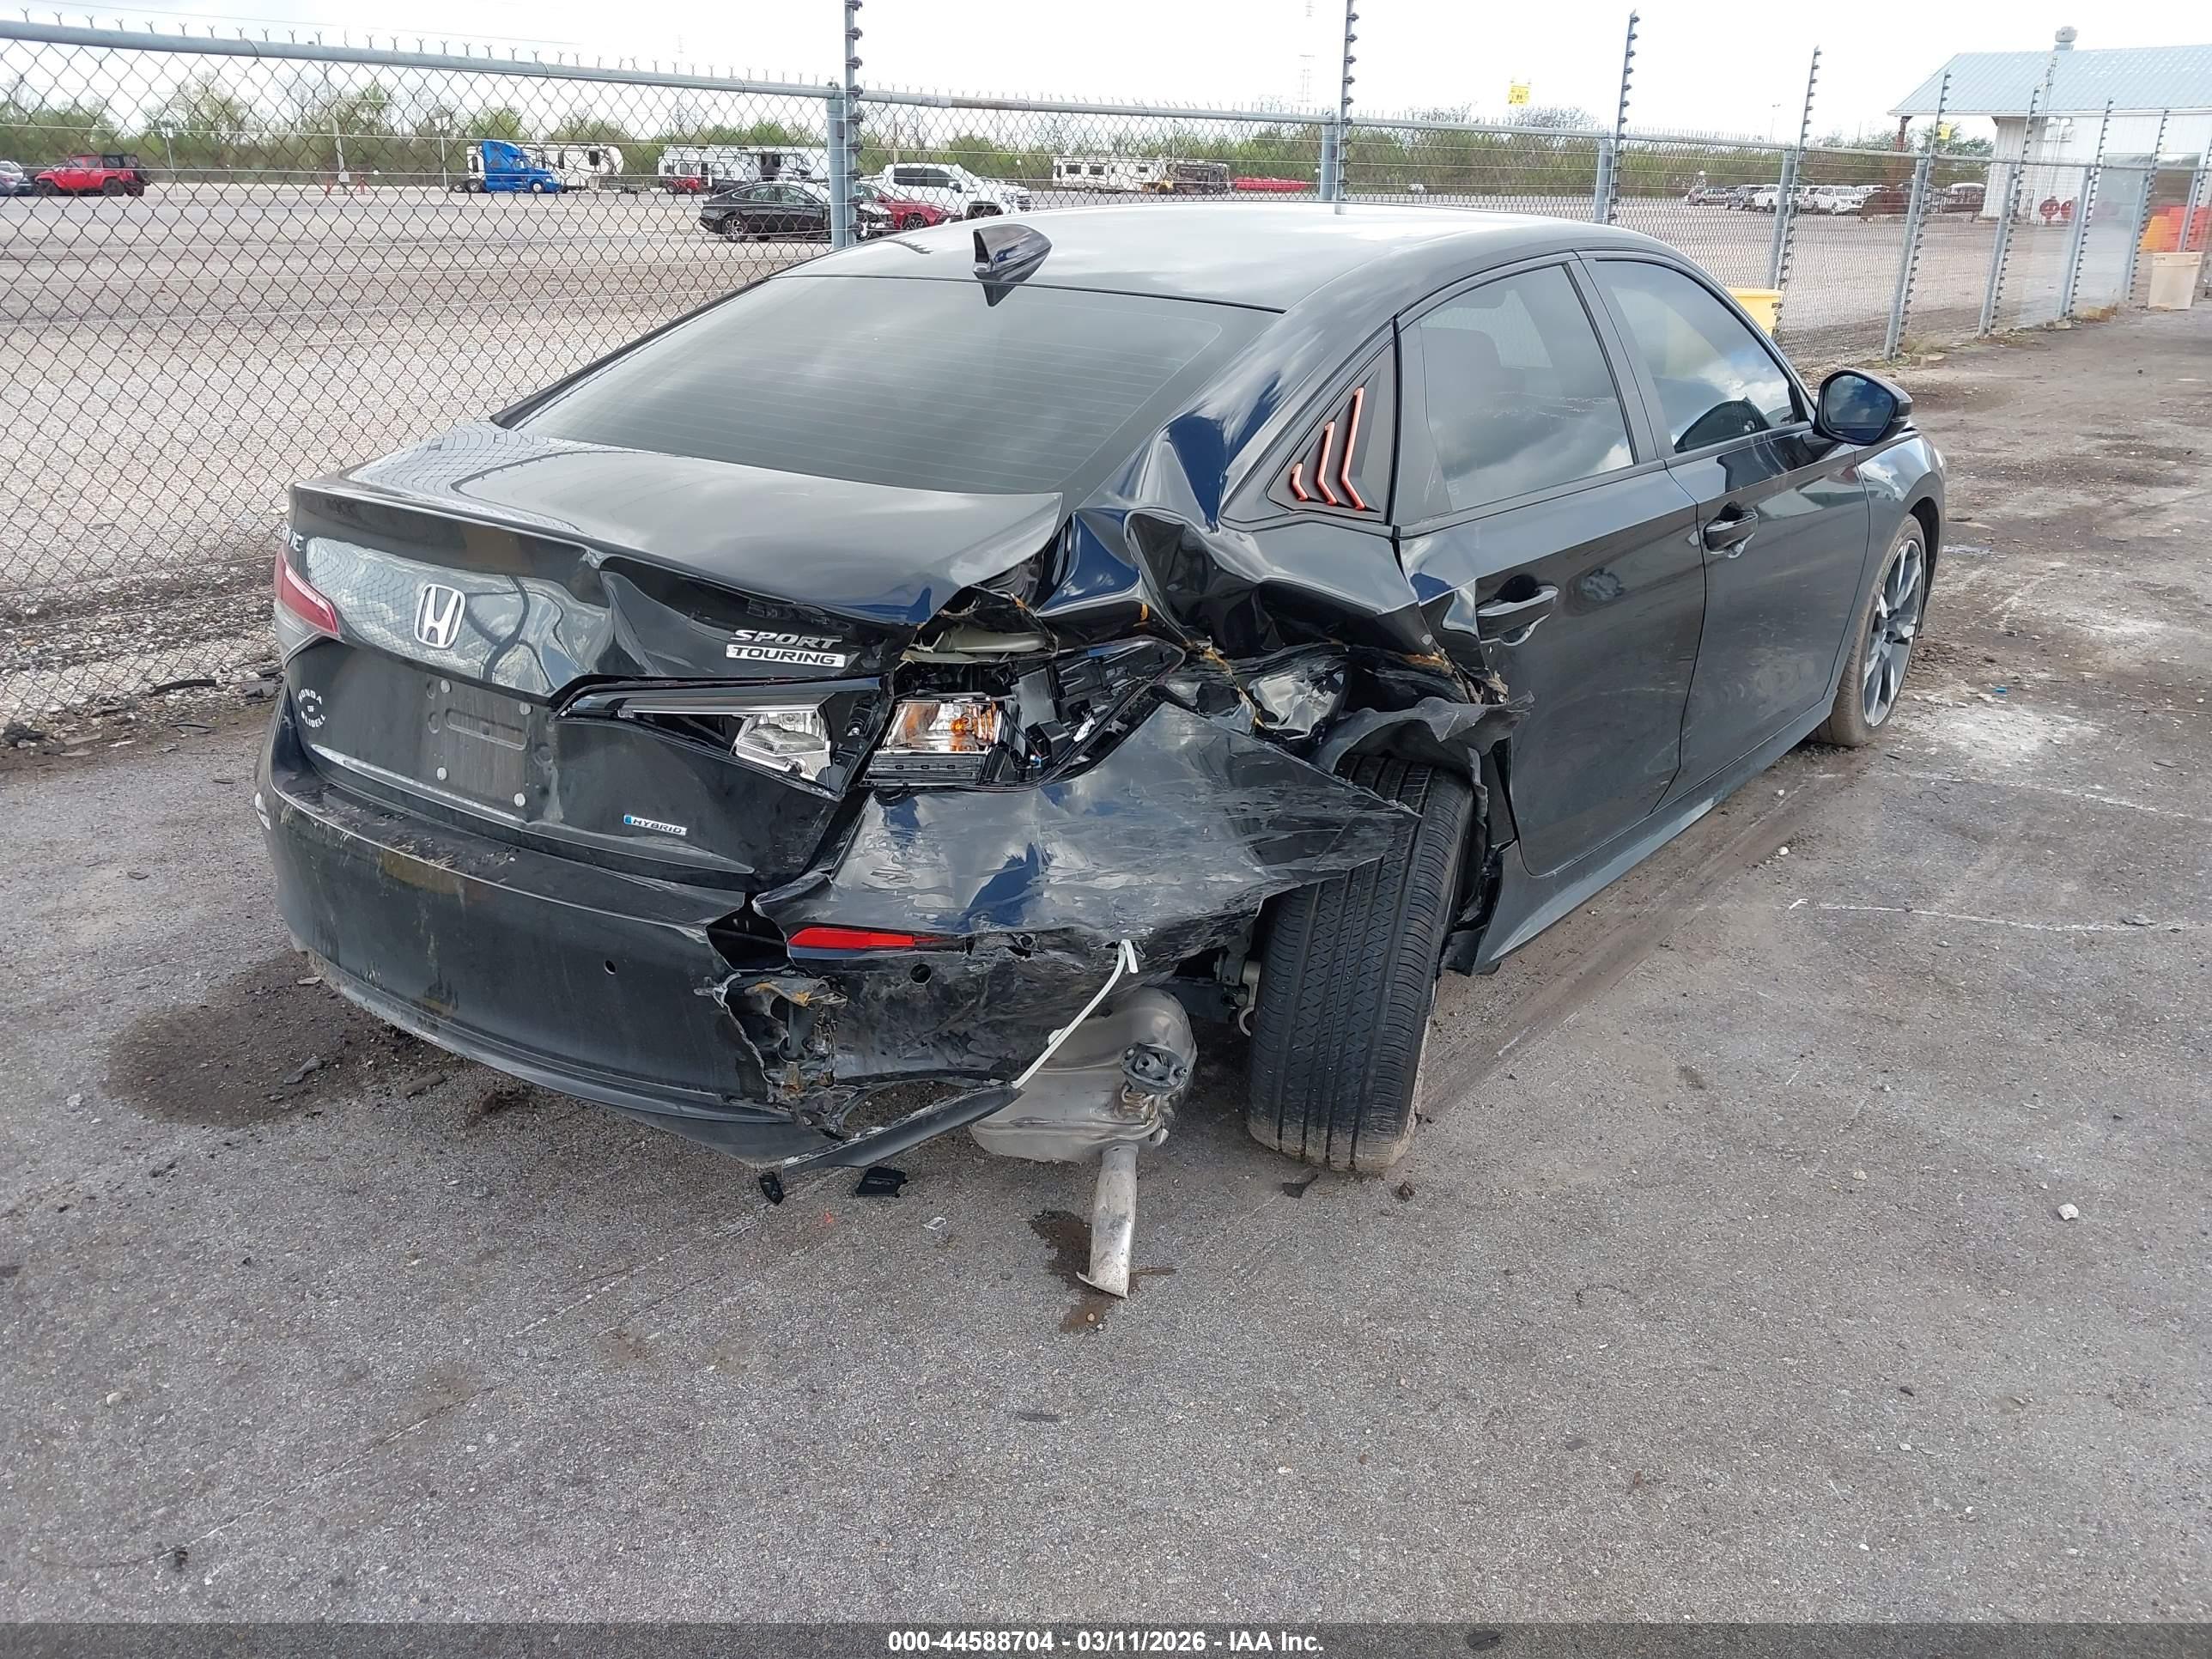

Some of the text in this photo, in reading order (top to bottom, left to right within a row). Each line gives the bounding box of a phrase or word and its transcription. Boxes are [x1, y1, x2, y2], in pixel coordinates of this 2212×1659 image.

[731, 629, 843, 650] SPORT
[732, 646, 837, 665] TOURING
[297, 688, 322, 705] HONDA
[633, 818, 682, 834] HYBRID
